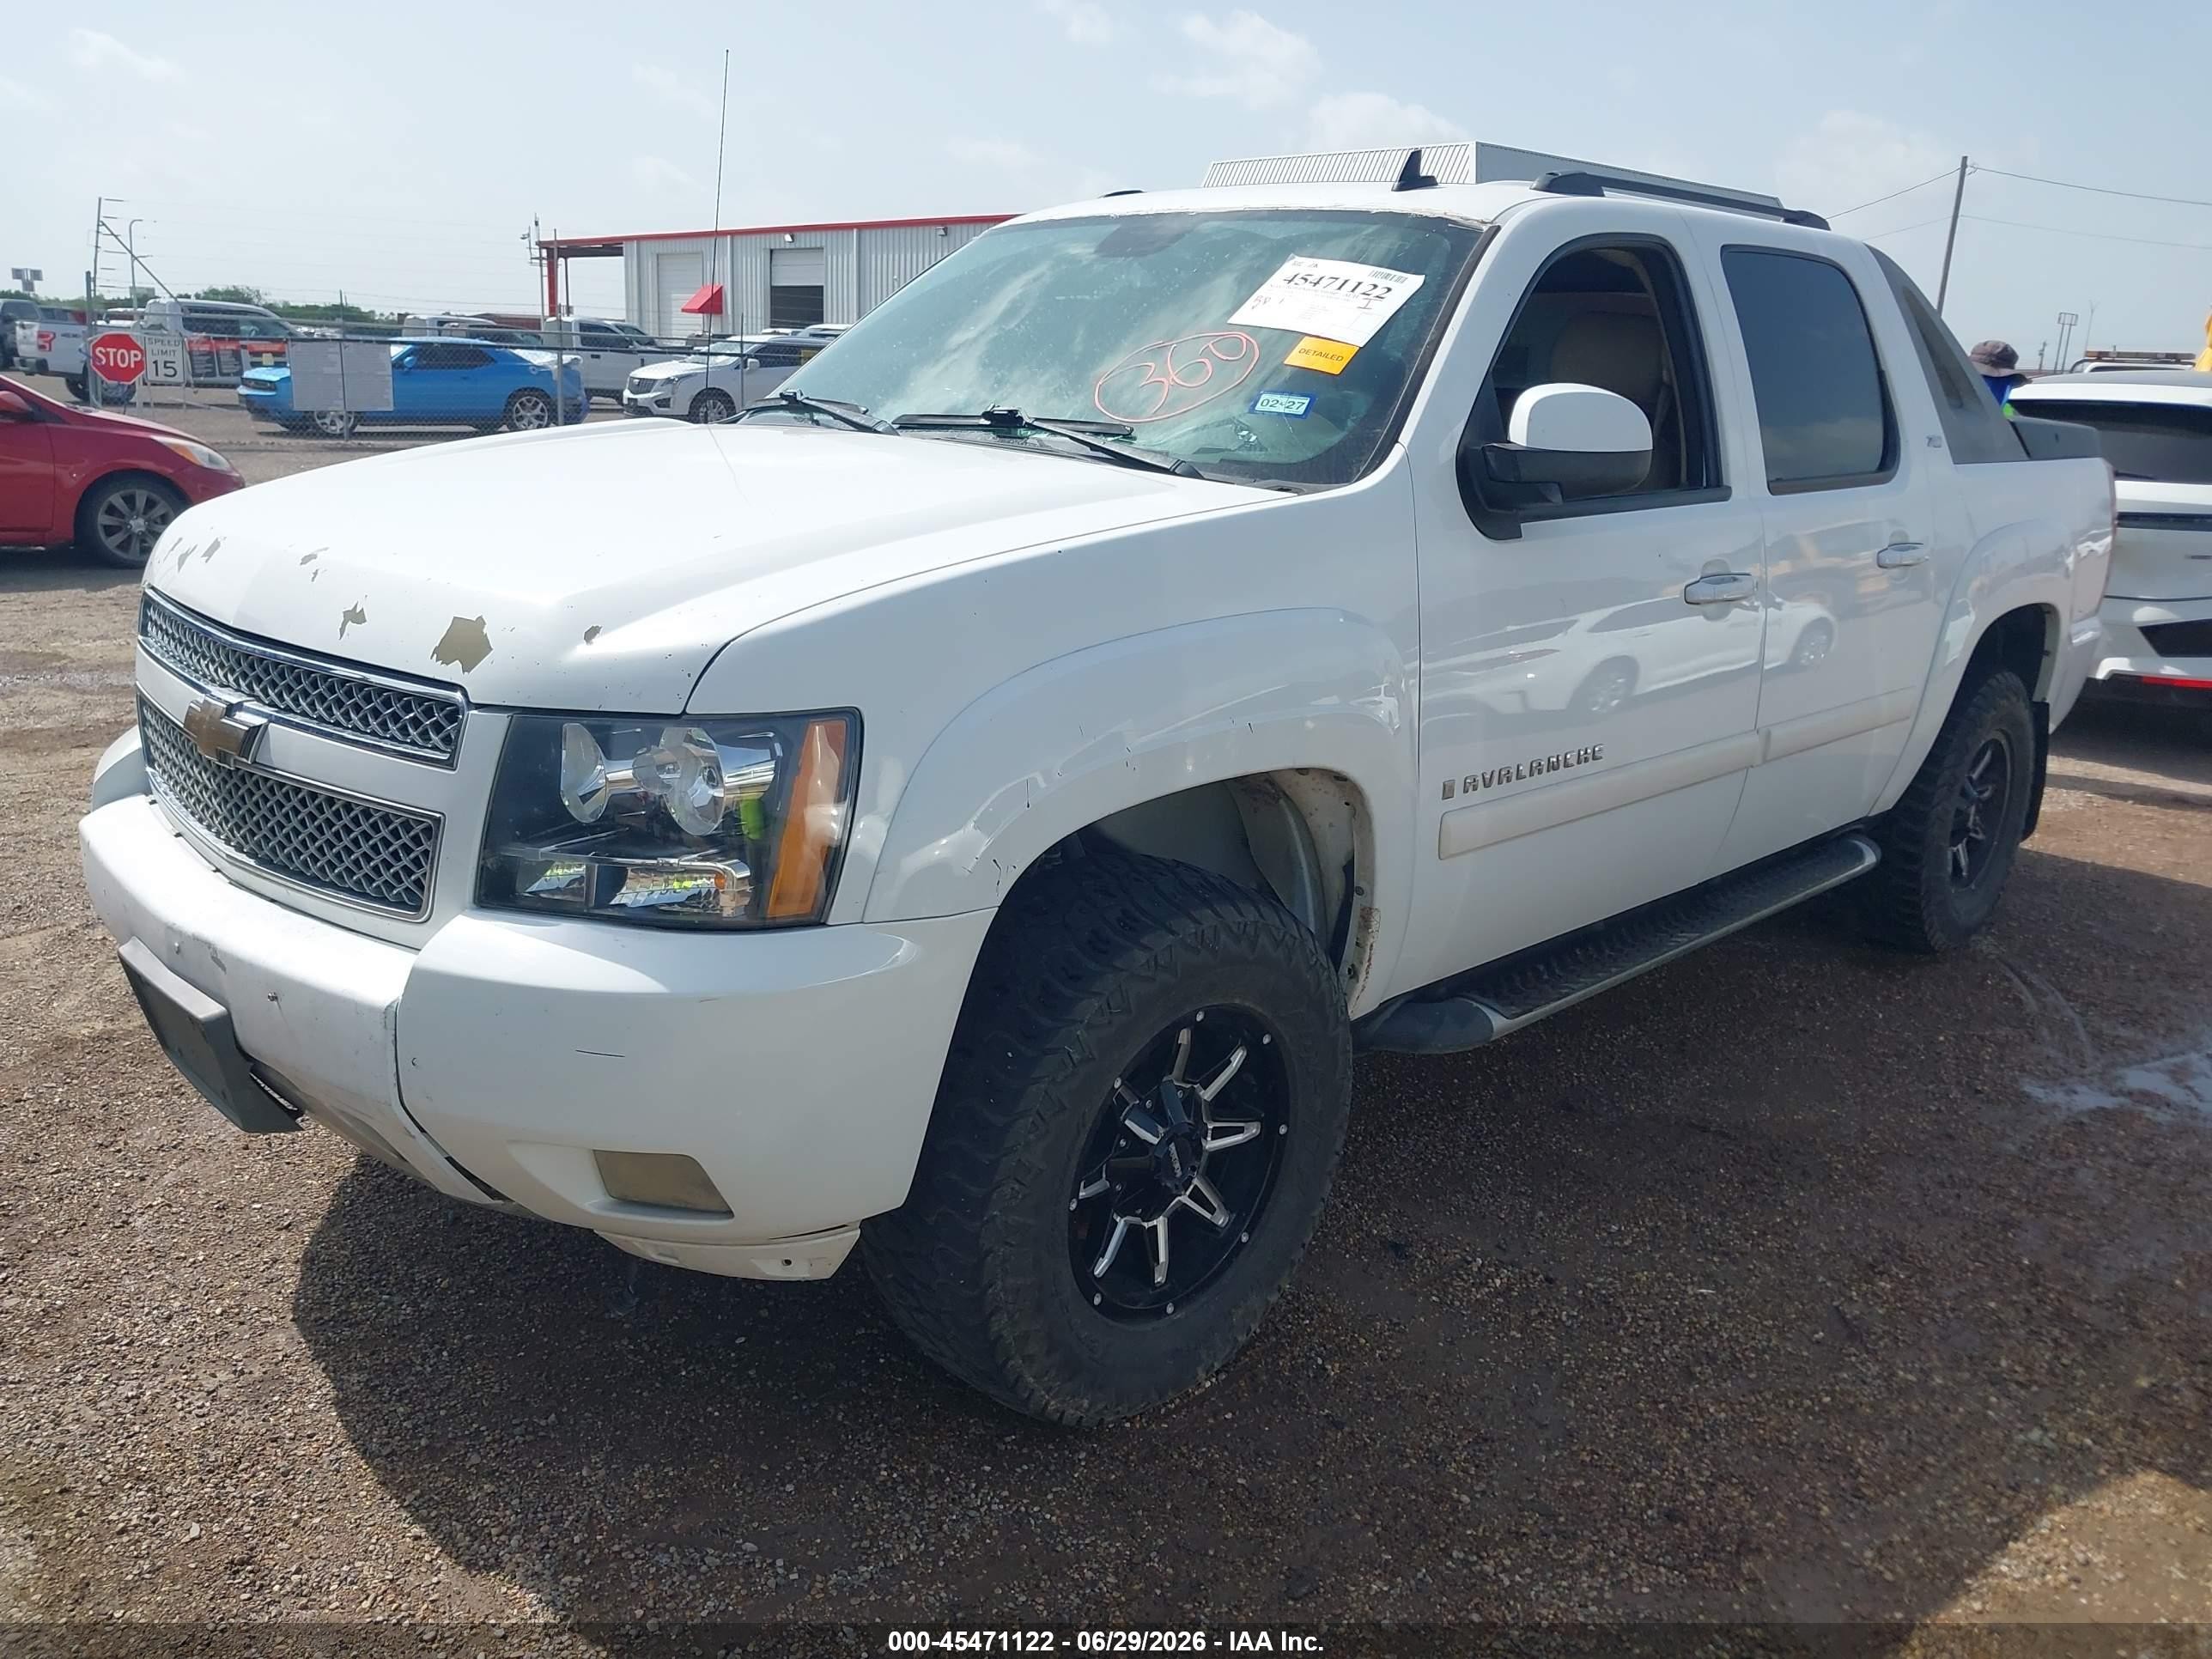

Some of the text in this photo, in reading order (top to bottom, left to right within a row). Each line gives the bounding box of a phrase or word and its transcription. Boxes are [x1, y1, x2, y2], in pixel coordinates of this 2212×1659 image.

[1283, 271, 1393, 300] 45471122
[148, 337, 180, 347] SPEED
[95, 346, 142, 368] STOP
[151, 349, 177, 357] LIMIT
[1298, 347, 1345, 362] DETAILED
[153, 359, 178, 378] 15
[1101, 334, 1247, 415] 360
[1462, 743, 1605, 794] AVALANCHE
